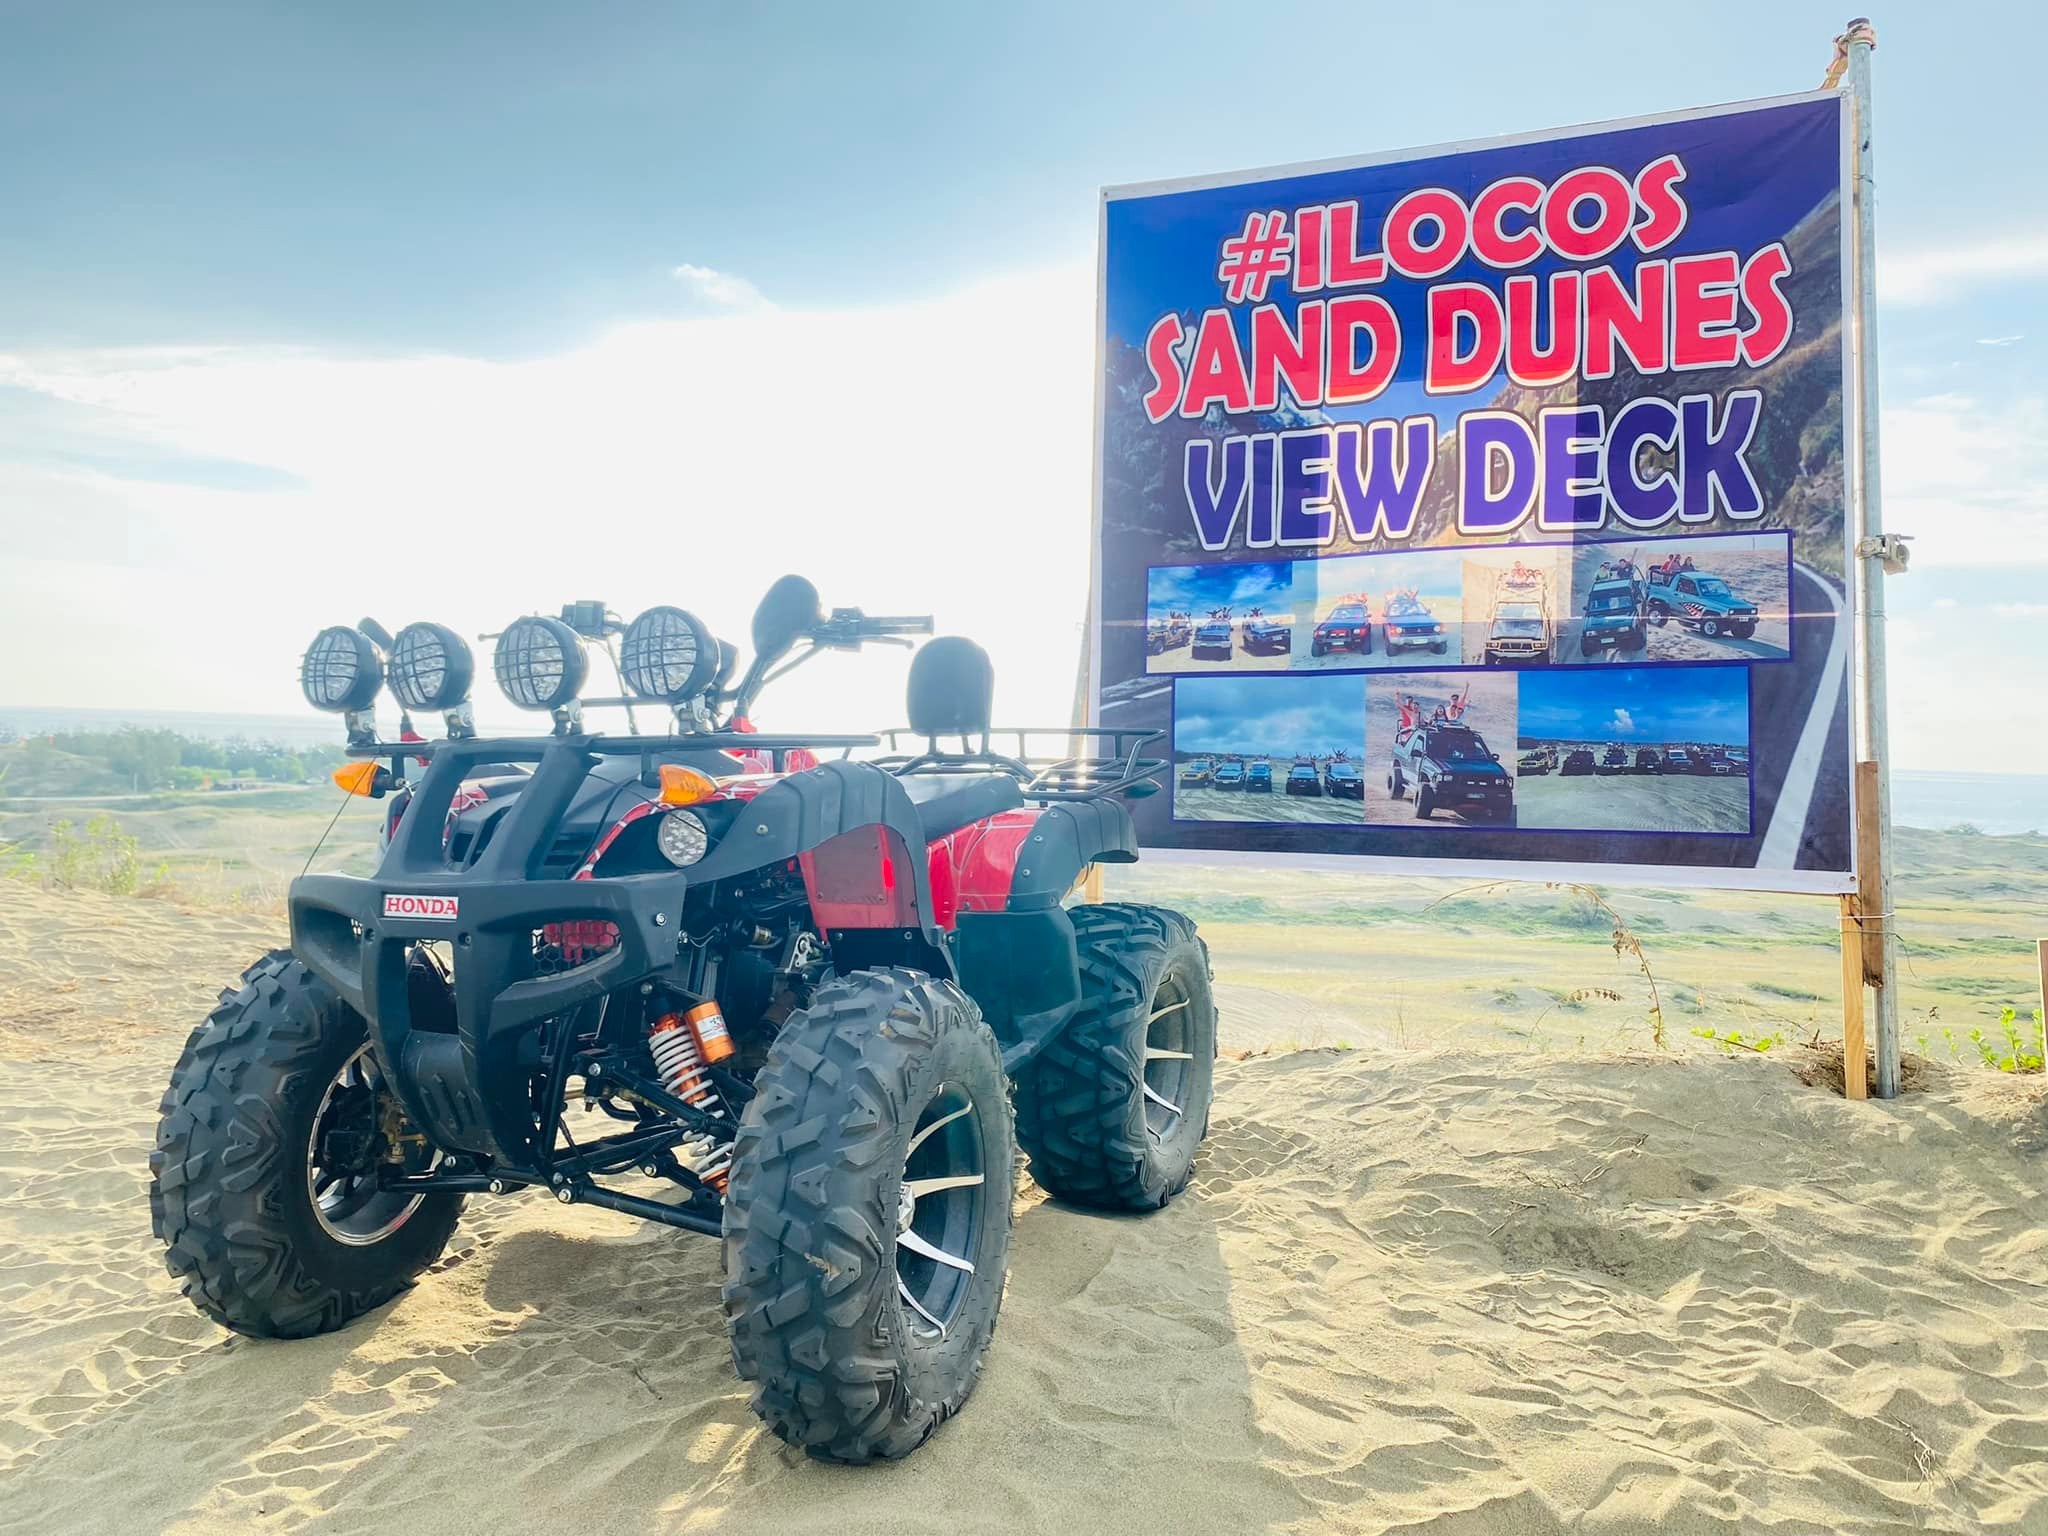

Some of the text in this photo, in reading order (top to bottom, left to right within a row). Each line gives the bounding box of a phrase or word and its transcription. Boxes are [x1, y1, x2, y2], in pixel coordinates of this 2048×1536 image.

[1219, 154, 1687, 302] #ILOCOS
[1144, 242, 1793, 424] SAND DUNES
[1184, 389, 1766, 551] VIEW DECK
[386, 897, 458, 915] HONDA
